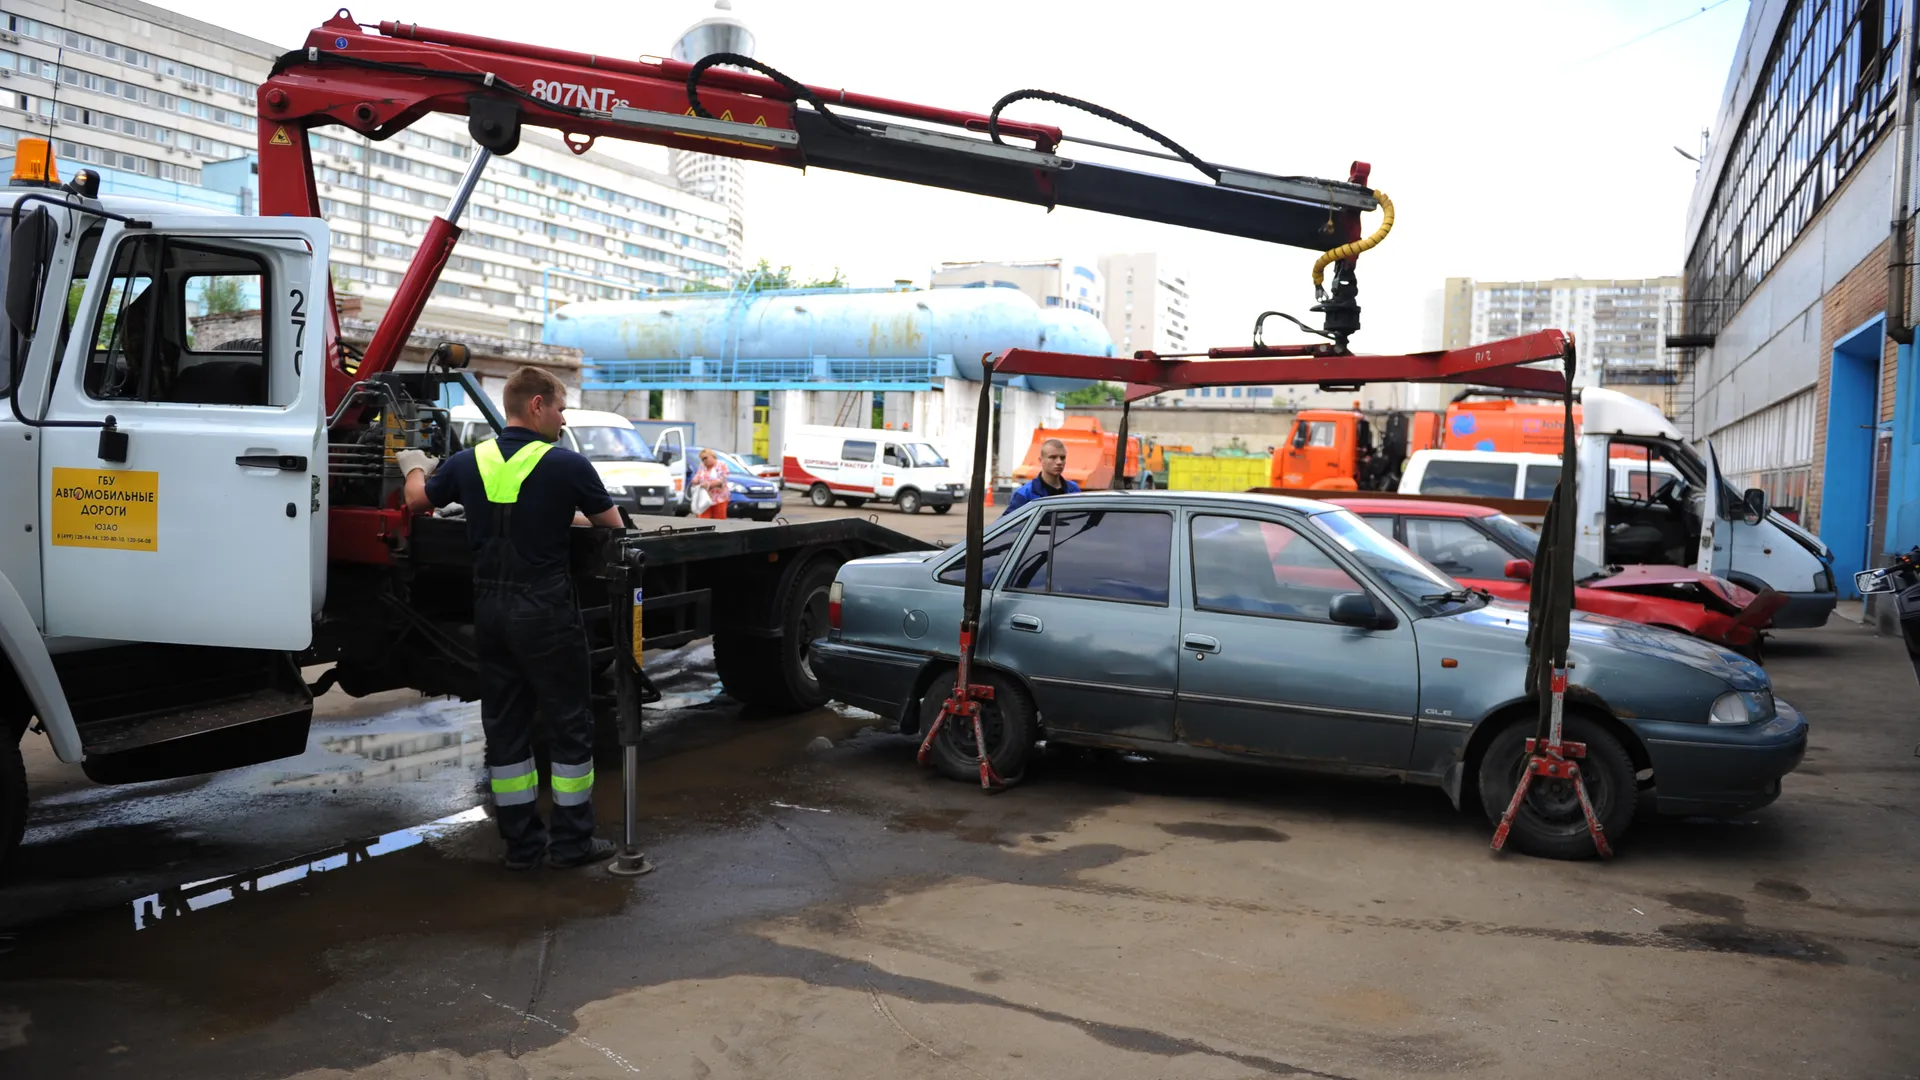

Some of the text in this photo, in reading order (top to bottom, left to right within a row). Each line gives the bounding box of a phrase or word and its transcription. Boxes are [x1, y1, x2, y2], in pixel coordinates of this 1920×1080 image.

[98, 476, 115, 486] ГБУ
[55, 487, 154, 502] АВТОМОБИЛЬНЫЕ
[80, 504, 126, 516] ДОРОГИ
[94, 523, 118, 532] ЮЗАО
[1425, 708, 1452, 716] GLE
